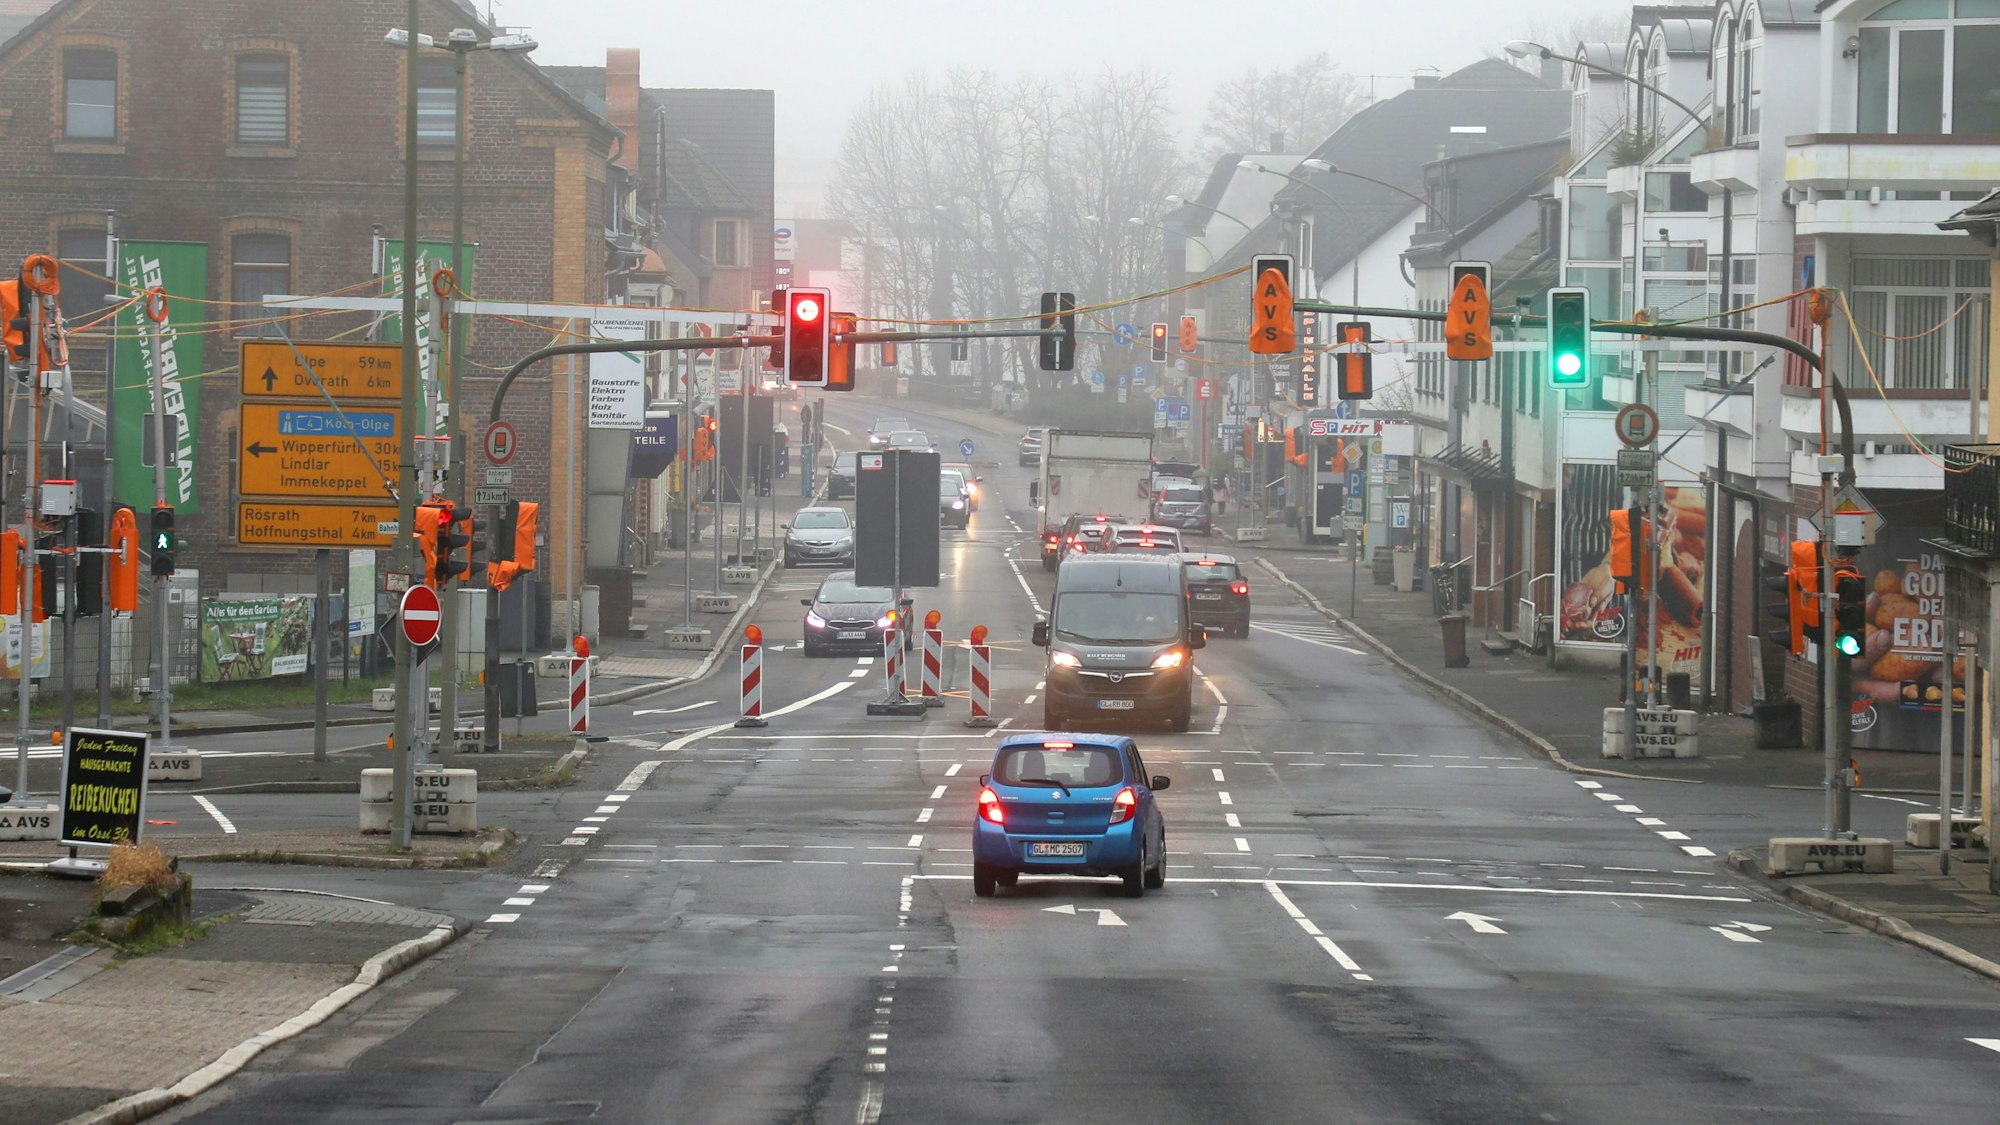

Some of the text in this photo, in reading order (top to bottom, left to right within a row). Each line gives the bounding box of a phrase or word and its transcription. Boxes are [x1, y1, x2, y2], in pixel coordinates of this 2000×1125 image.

[1264, 283, 1277, 341] AVS
[1464, 288, 1476, 346] AVS
[359, 357, 374, 369] 59
[377, 358, 392, 369] km
[367, 377, 374, 388] 6
[376, 377, 391, 388] km
[375, 442, 391, 454] 30
[634, 436, 666, 445] TEILE
[281, 458, 330, 470] Lindlar
[378, 460, 391, 472] 15
[280, 475, 367, 490] Immekeppel
[245, 508, 376, 523] Rösrath 7 km
[244, 525, 376, 540] Hoffnungsthal 4 km
[1920, 554, 1944, 570] DA
[227, 607, 237, 616] für
[239, 606, 253, 616] den
[254, 605, 278, 614] Garten
[1894, 617, 1945, 648] ERD
[1674, 646, 1701, 662] HIT
[76, 738, 138, 756] Jeden Freitag
[80, 758, 132, 773] HAUSGEMACHTE
[162, 760, 190, 770] AVS
[69, 784, 138, 815] REIBEKUCHEN
[17, 816, 50, 828] AVS
[72, 824, 129, 840] im Ossi 30
[1033, 845, 1083, 854] GL MC 2507
[1808, 845, 1866, 856] AVS.EU
